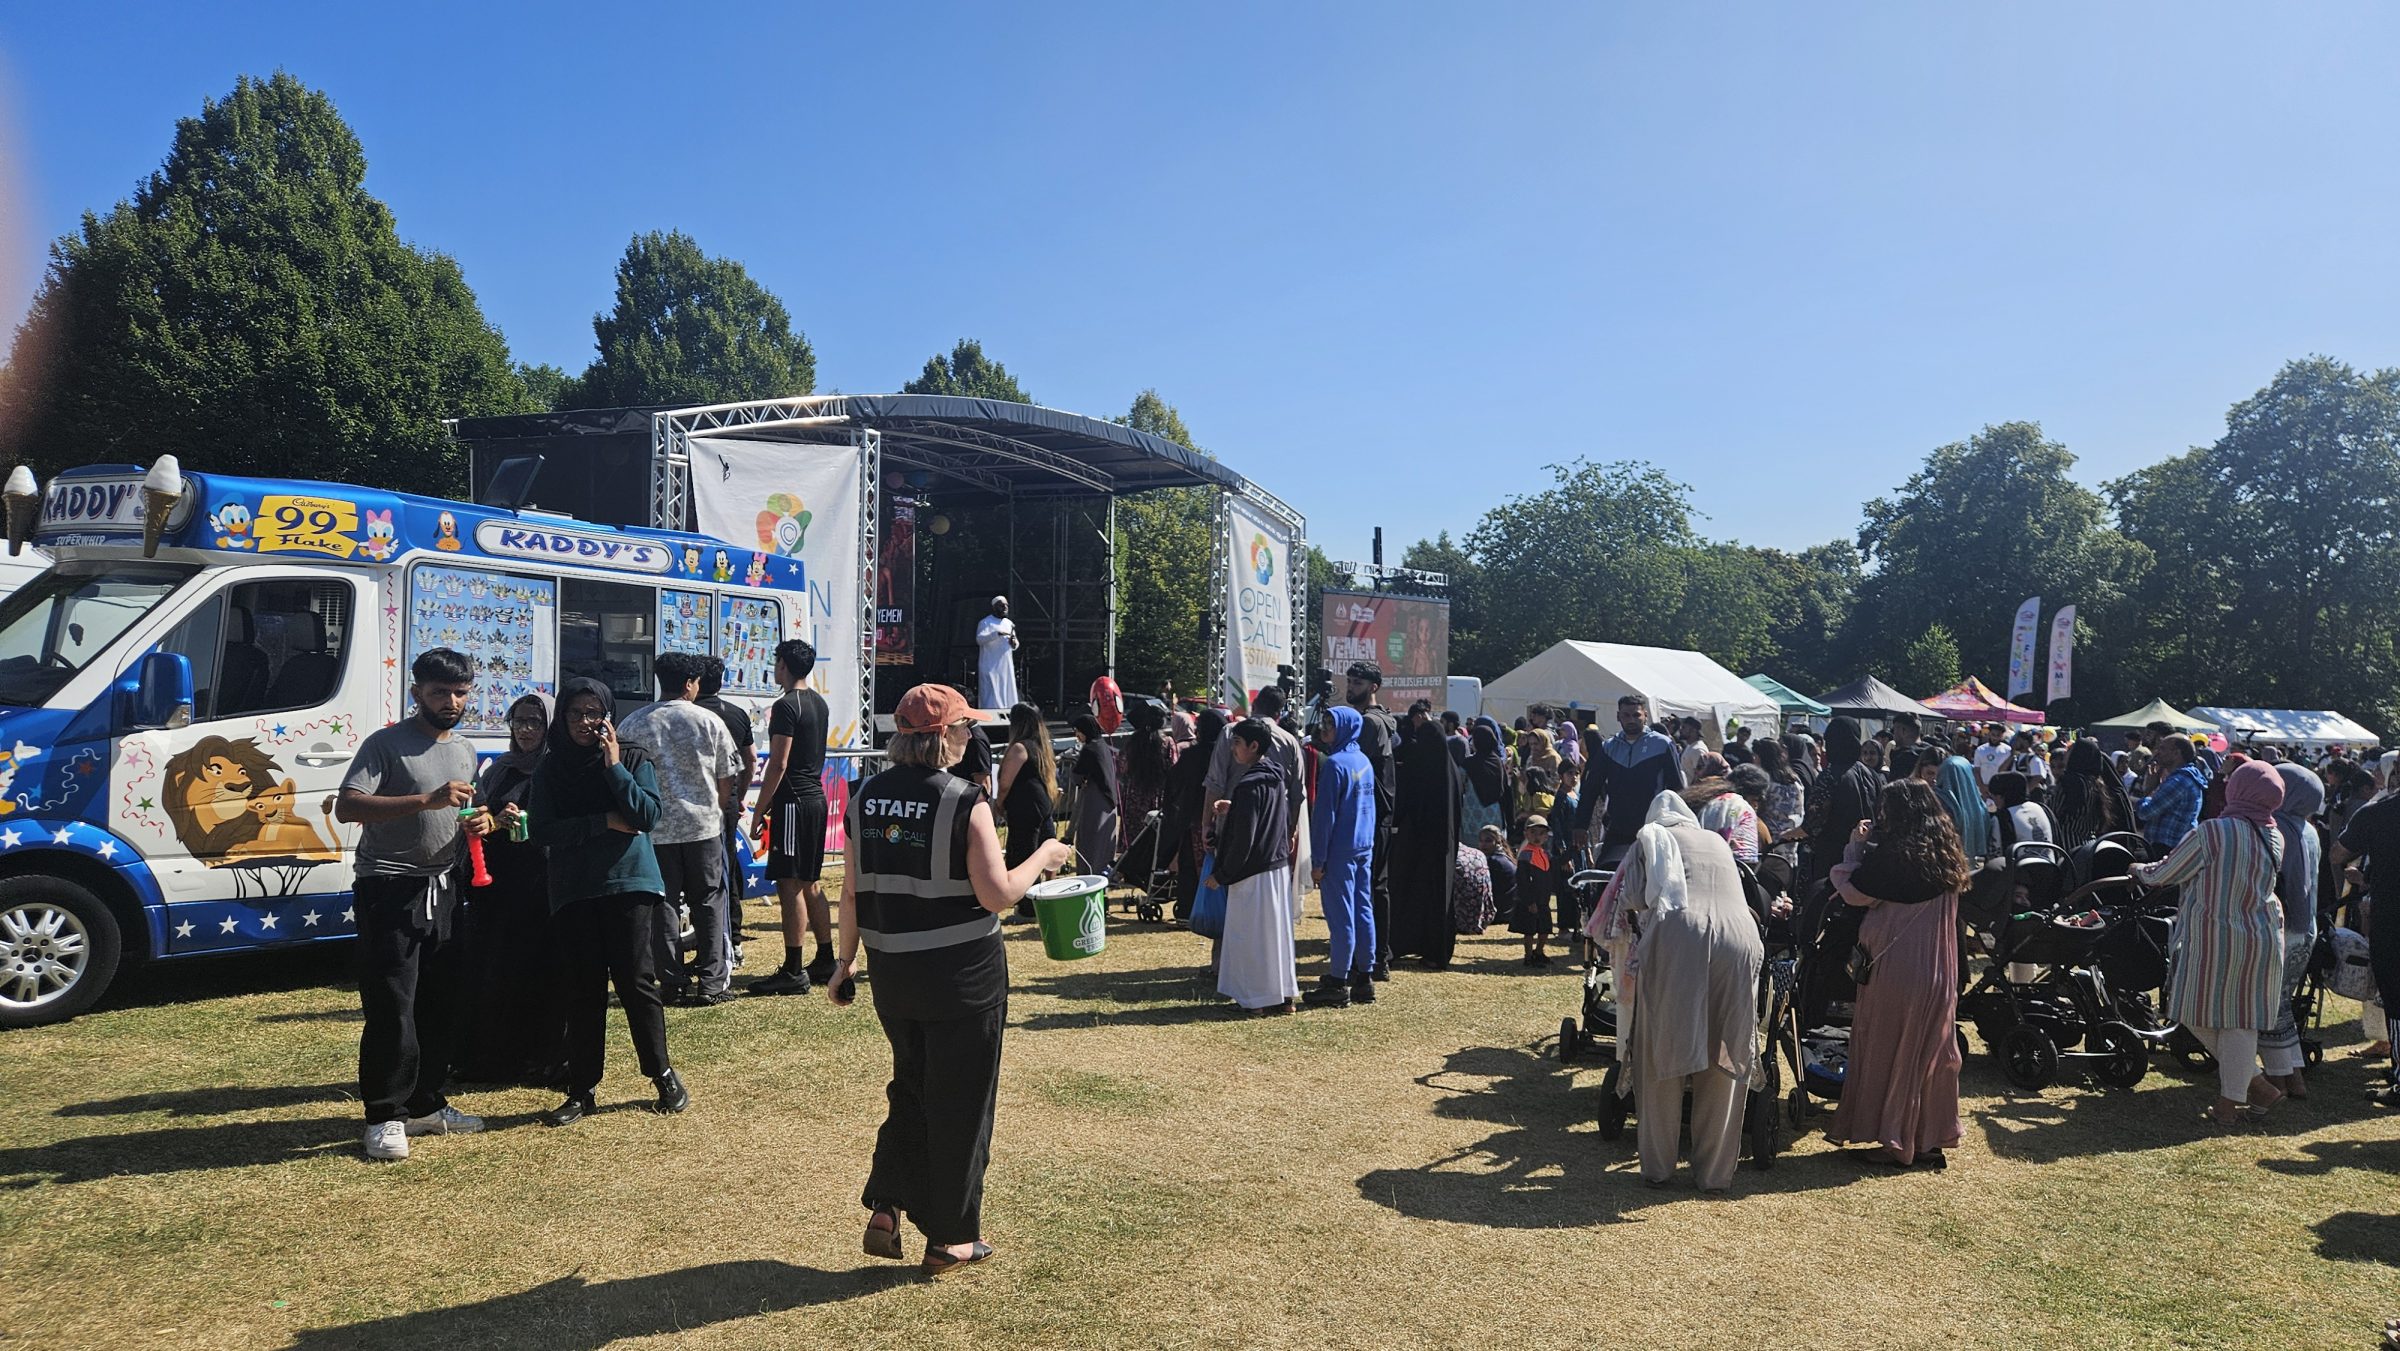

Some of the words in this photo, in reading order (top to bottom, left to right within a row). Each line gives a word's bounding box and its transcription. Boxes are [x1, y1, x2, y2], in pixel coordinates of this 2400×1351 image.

[275, 506, 337, 534] 99
[55, 535, 106, 547] SUPERWHIP
[275, 533, 343, 551] Flake
[500, 529, 653, 563] KADDY'S
[1239, 587, 1281, 620] OPEN
[877, 608, 902, 624] YEMEN
[1240, 616, 1282, 649] CALL
[1327, 636, 1376, 660] YEMEN
[864, 798, 929, 819] STAFF
